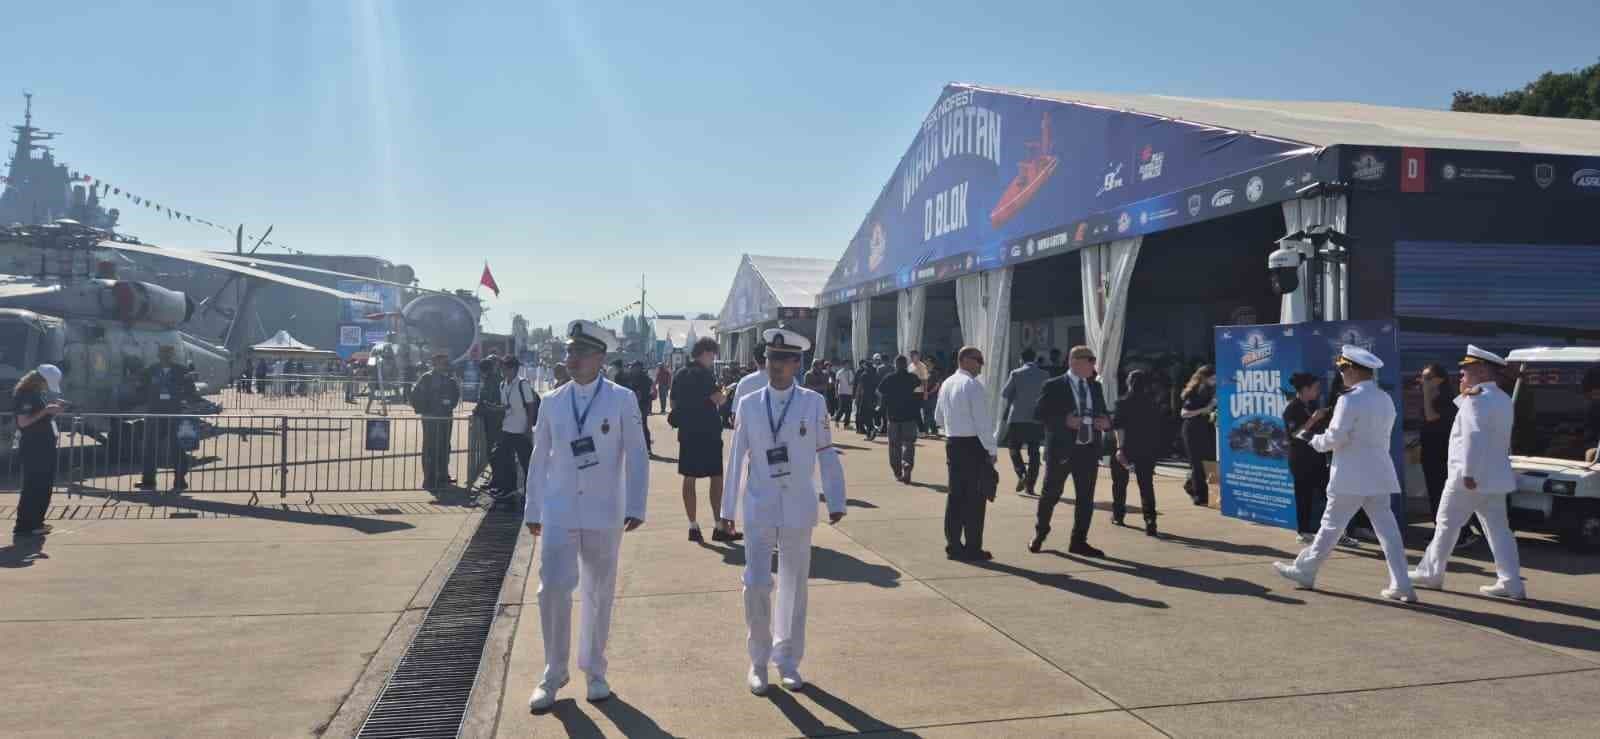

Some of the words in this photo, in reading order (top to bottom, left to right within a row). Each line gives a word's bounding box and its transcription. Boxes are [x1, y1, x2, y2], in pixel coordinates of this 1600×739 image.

[1408, 158, 1418, 178] D
[924, 199, 933, 241] D
[935, 181, 968, 236] BLOK
